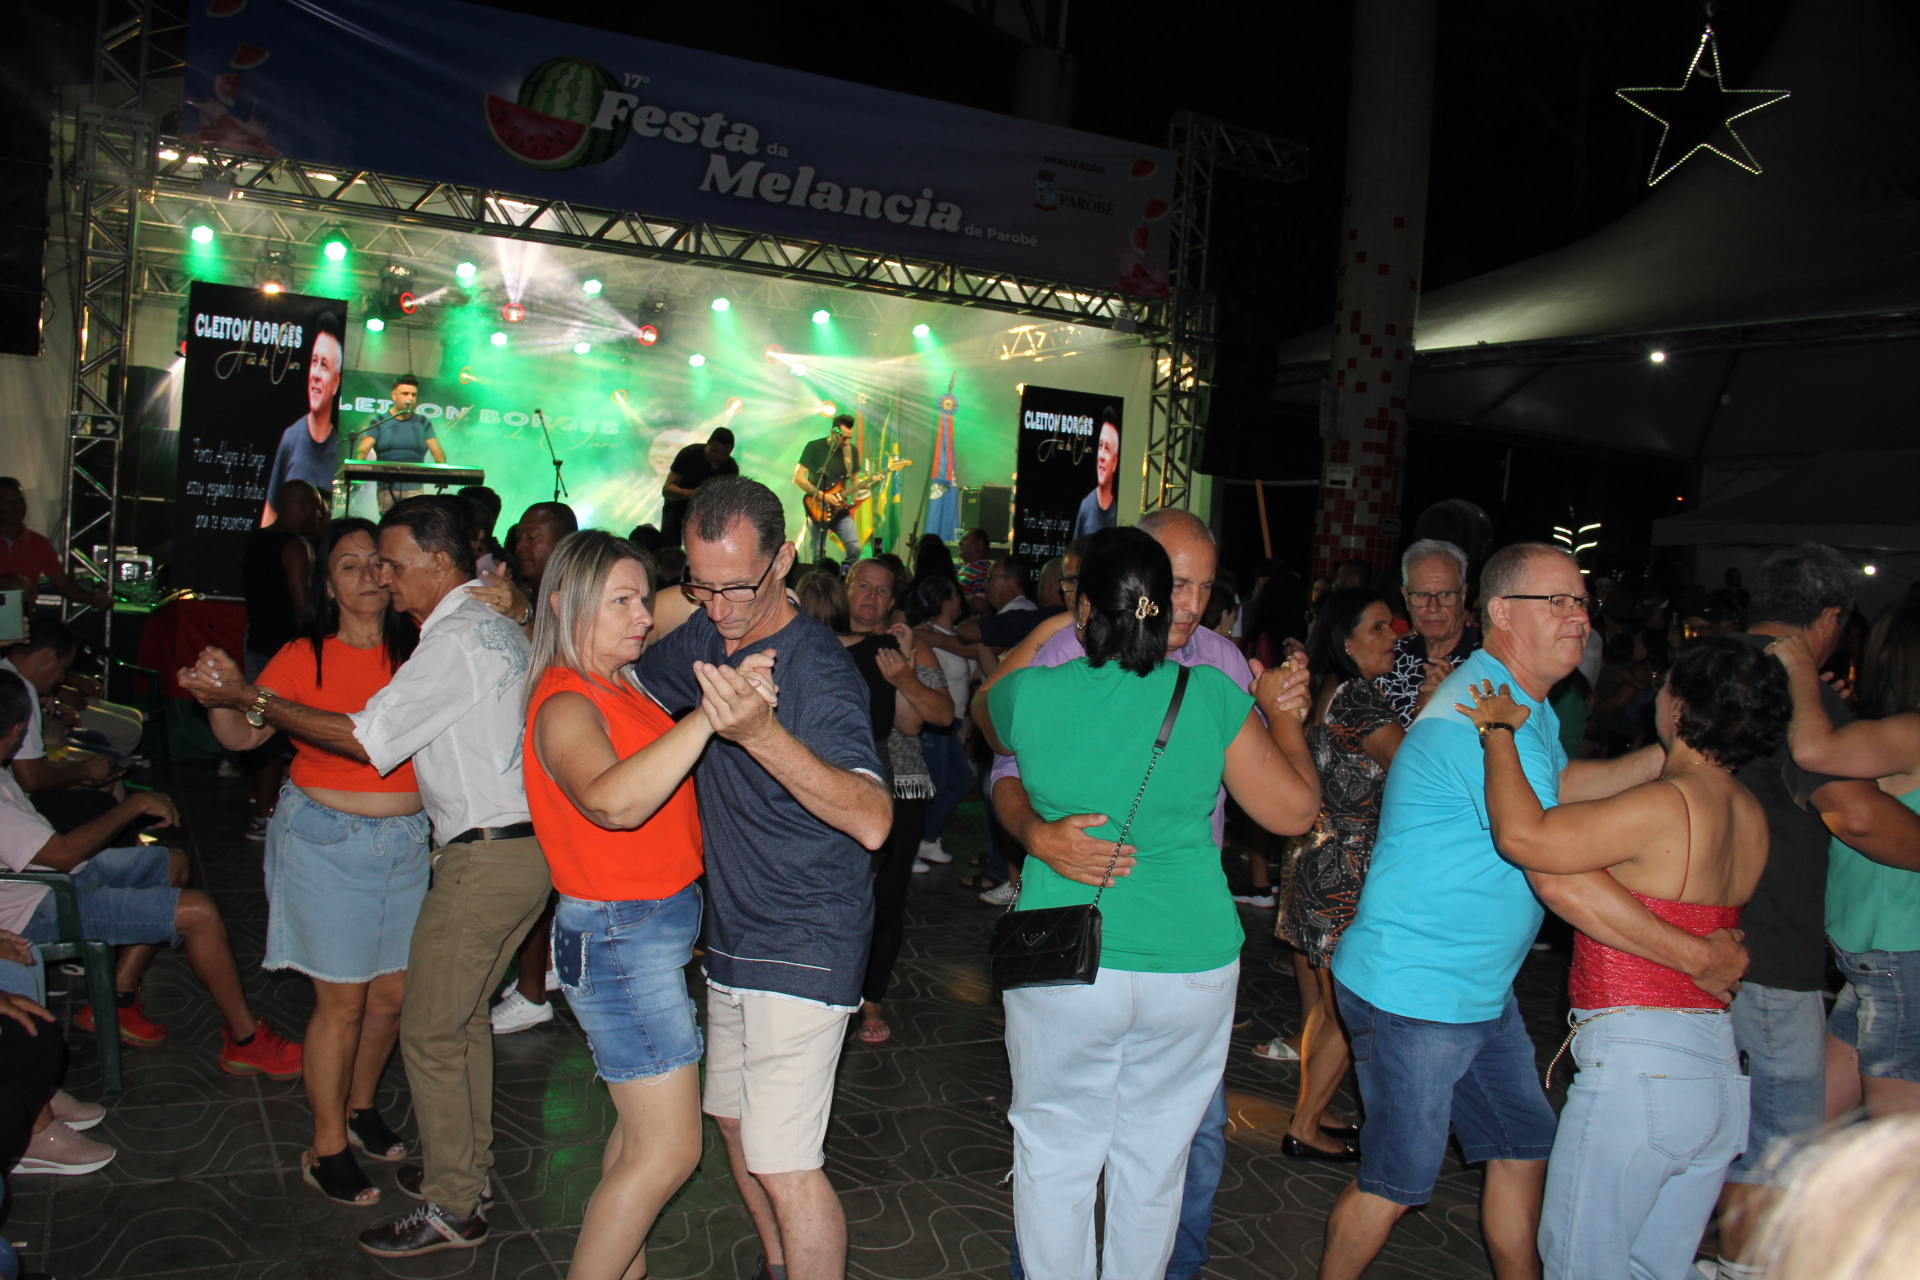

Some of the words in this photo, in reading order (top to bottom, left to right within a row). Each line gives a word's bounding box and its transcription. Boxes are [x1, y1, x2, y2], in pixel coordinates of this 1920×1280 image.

[590, 89, 760, 155] Festa
[766, 142, 789, 157] da
[698, 153, 963, 233] Melancia
[964, 223, 983, 238] de
[986, 227, 1039, 247] Parobé
[1059, 193, 1115, 216] PAROBÉ
[195, 312, 251, 342] CLEITON
[252, 320, 303, 349] BORGES
[479, 408, 619, 436] BORGES
[1024, 410, 1062, 432] CLEITON
[1061, 414, 1094, 437] BORGES
